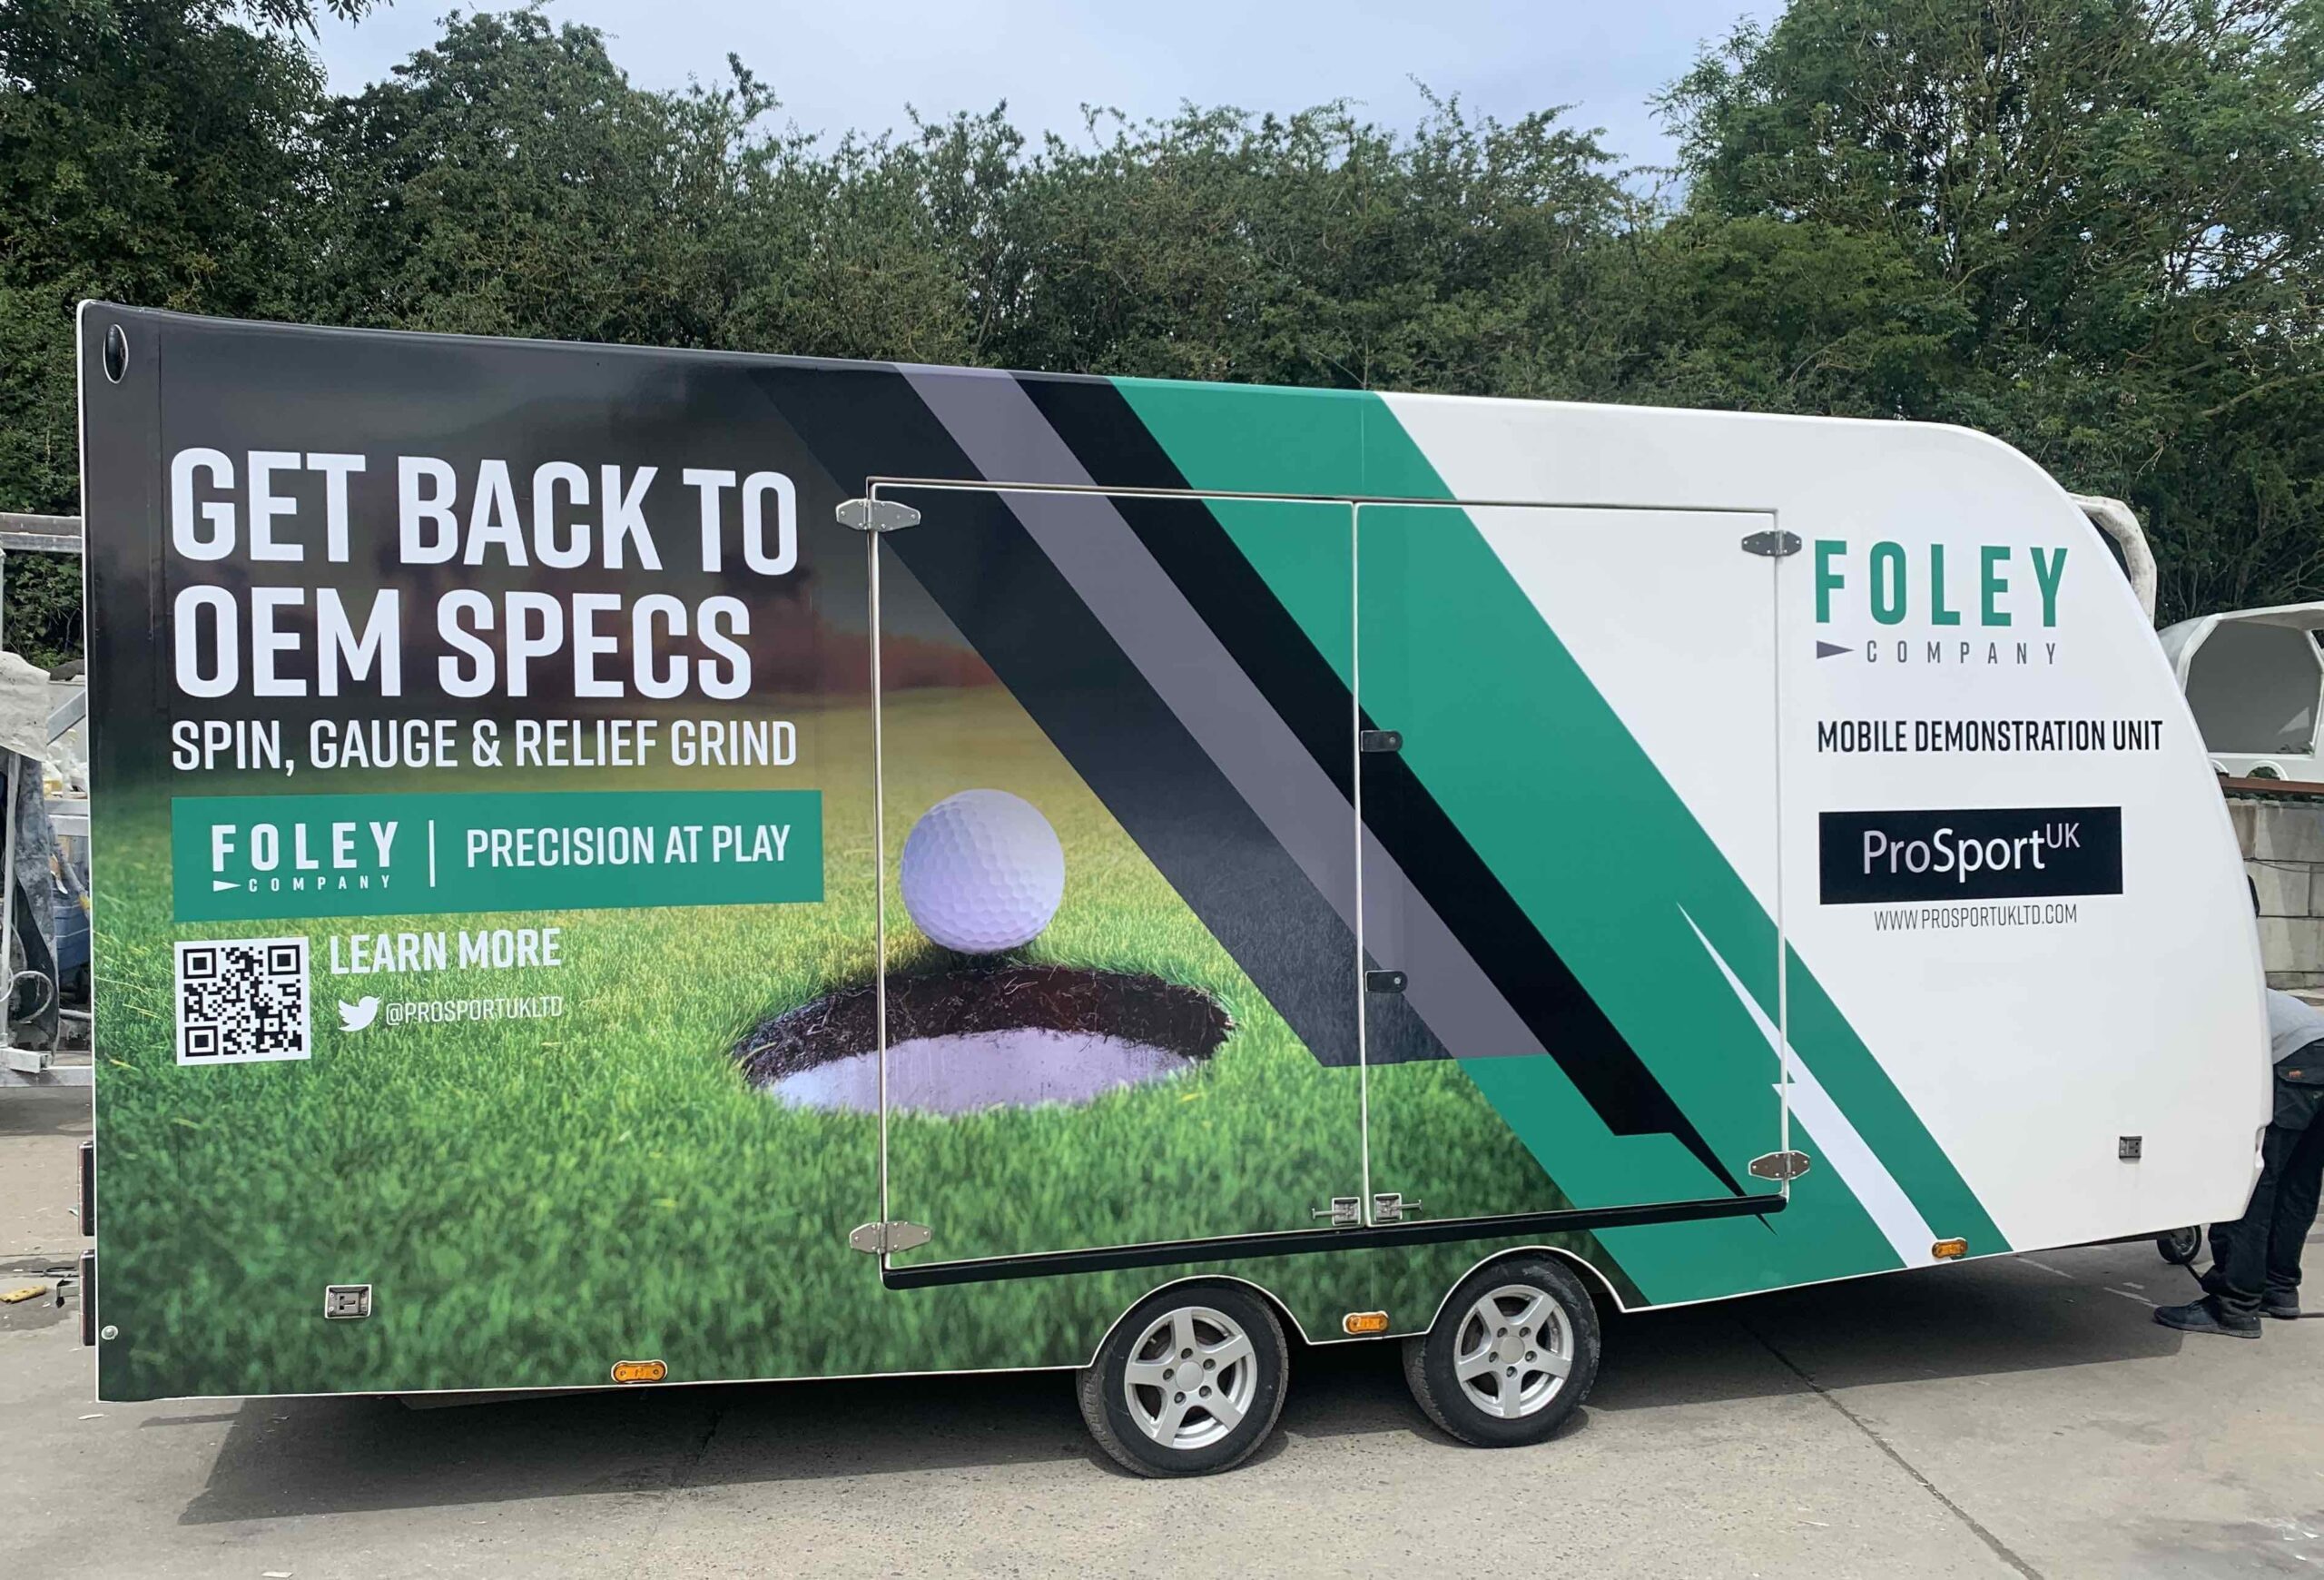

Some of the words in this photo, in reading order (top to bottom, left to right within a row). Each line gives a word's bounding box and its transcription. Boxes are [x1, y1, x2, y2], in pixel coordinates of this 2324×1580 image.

[171, 447, 367, 562] GET
[398, 456, 663, 570] BACK
[683, 469, 798, 575] TO
[1816, 540, 2067, 627] FOLEY
[174, 585, 401, 698] OEM
[437, 588, 752, 699] SPECS
[1866, 639, 2056, 664] COMPANY
[172, 720, 294, 776] SPIN,
[310, 720, 458, 769] GAUGE
[472, 719, 502, 766] &
[516, 719, 657, 766] RELIEF
[671, 719, 797, 766] GRIND
[1817, 720, 1907, 753] MOBILE
[1915, 720, 2105, 751] DEMONSTRATION
[2112, 720, 2163, 750] UNIT
[212, 821, 399, 873] FOLEY
[467, 826, 655, 868] PRECISION
[664, 825, 704, 864] AT
[712, 825, 791, 863] PLAY
[249, 874, 391, 893] COMPANY
[330, 932, 447, 975] LEARN
[458, 926, 562, 970] MORE
[386, 995, 564, 1026] @PROSPORTUKLTD
